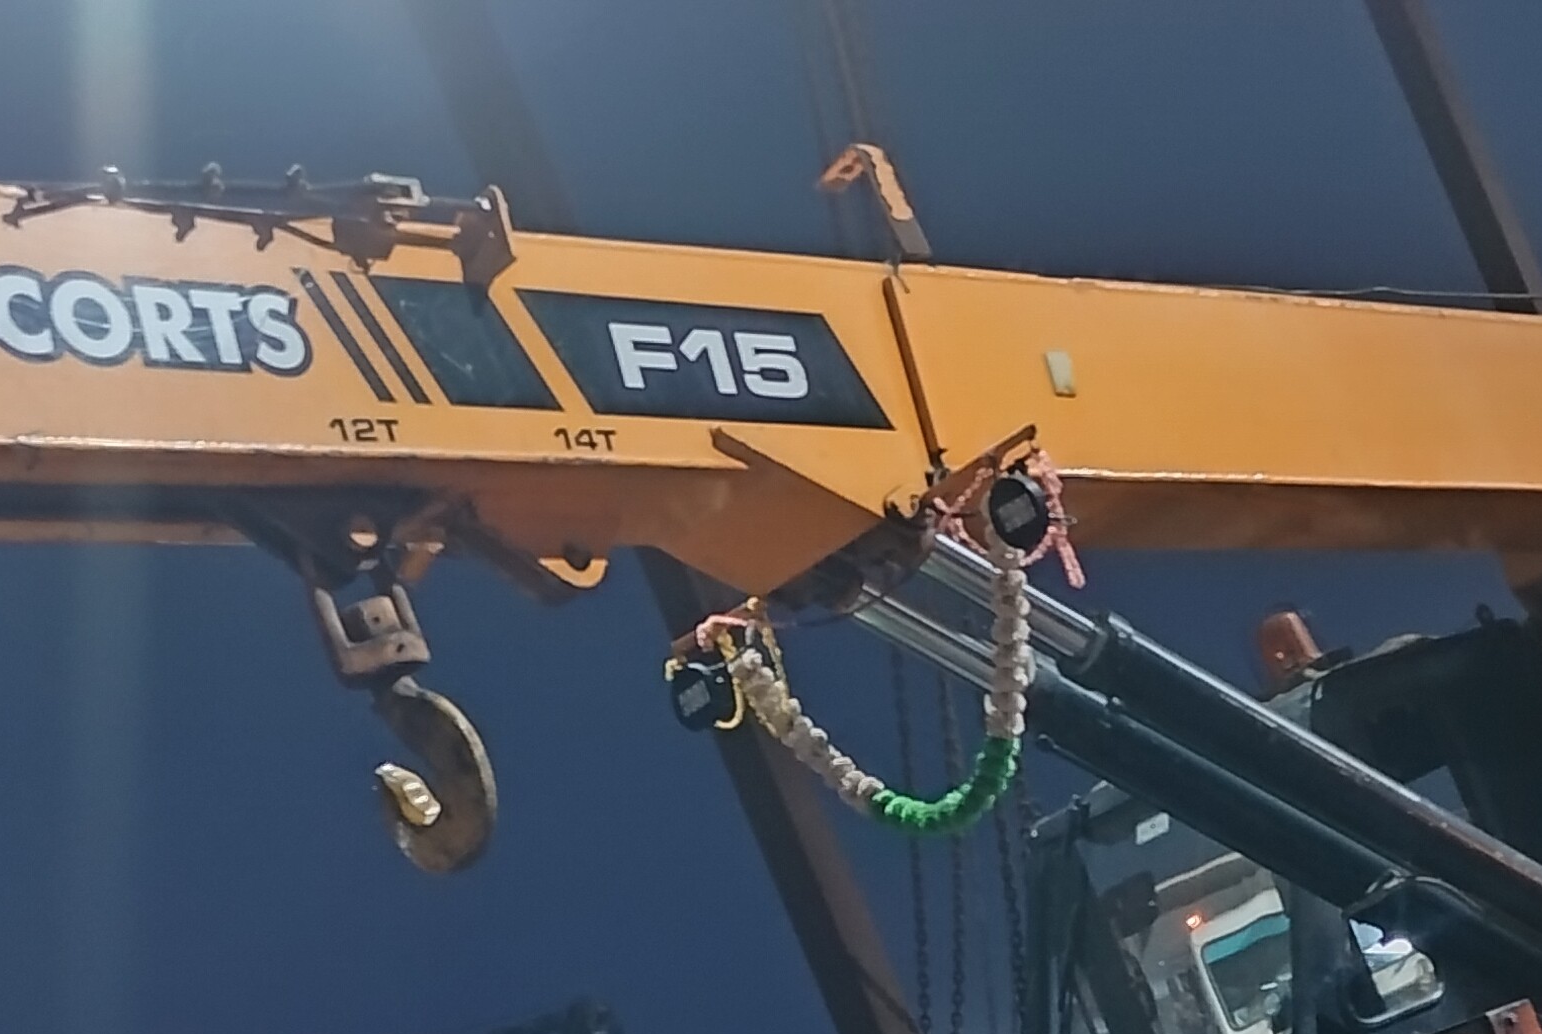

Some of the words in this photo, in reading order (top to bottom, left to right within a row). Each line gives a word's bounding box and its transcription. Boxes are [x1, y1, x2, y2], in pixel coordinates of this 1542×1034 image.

[607, 321, 810, 400] F15
[328, 417, 400, 443] 12T
[553, 427, 618, 452] 14T
